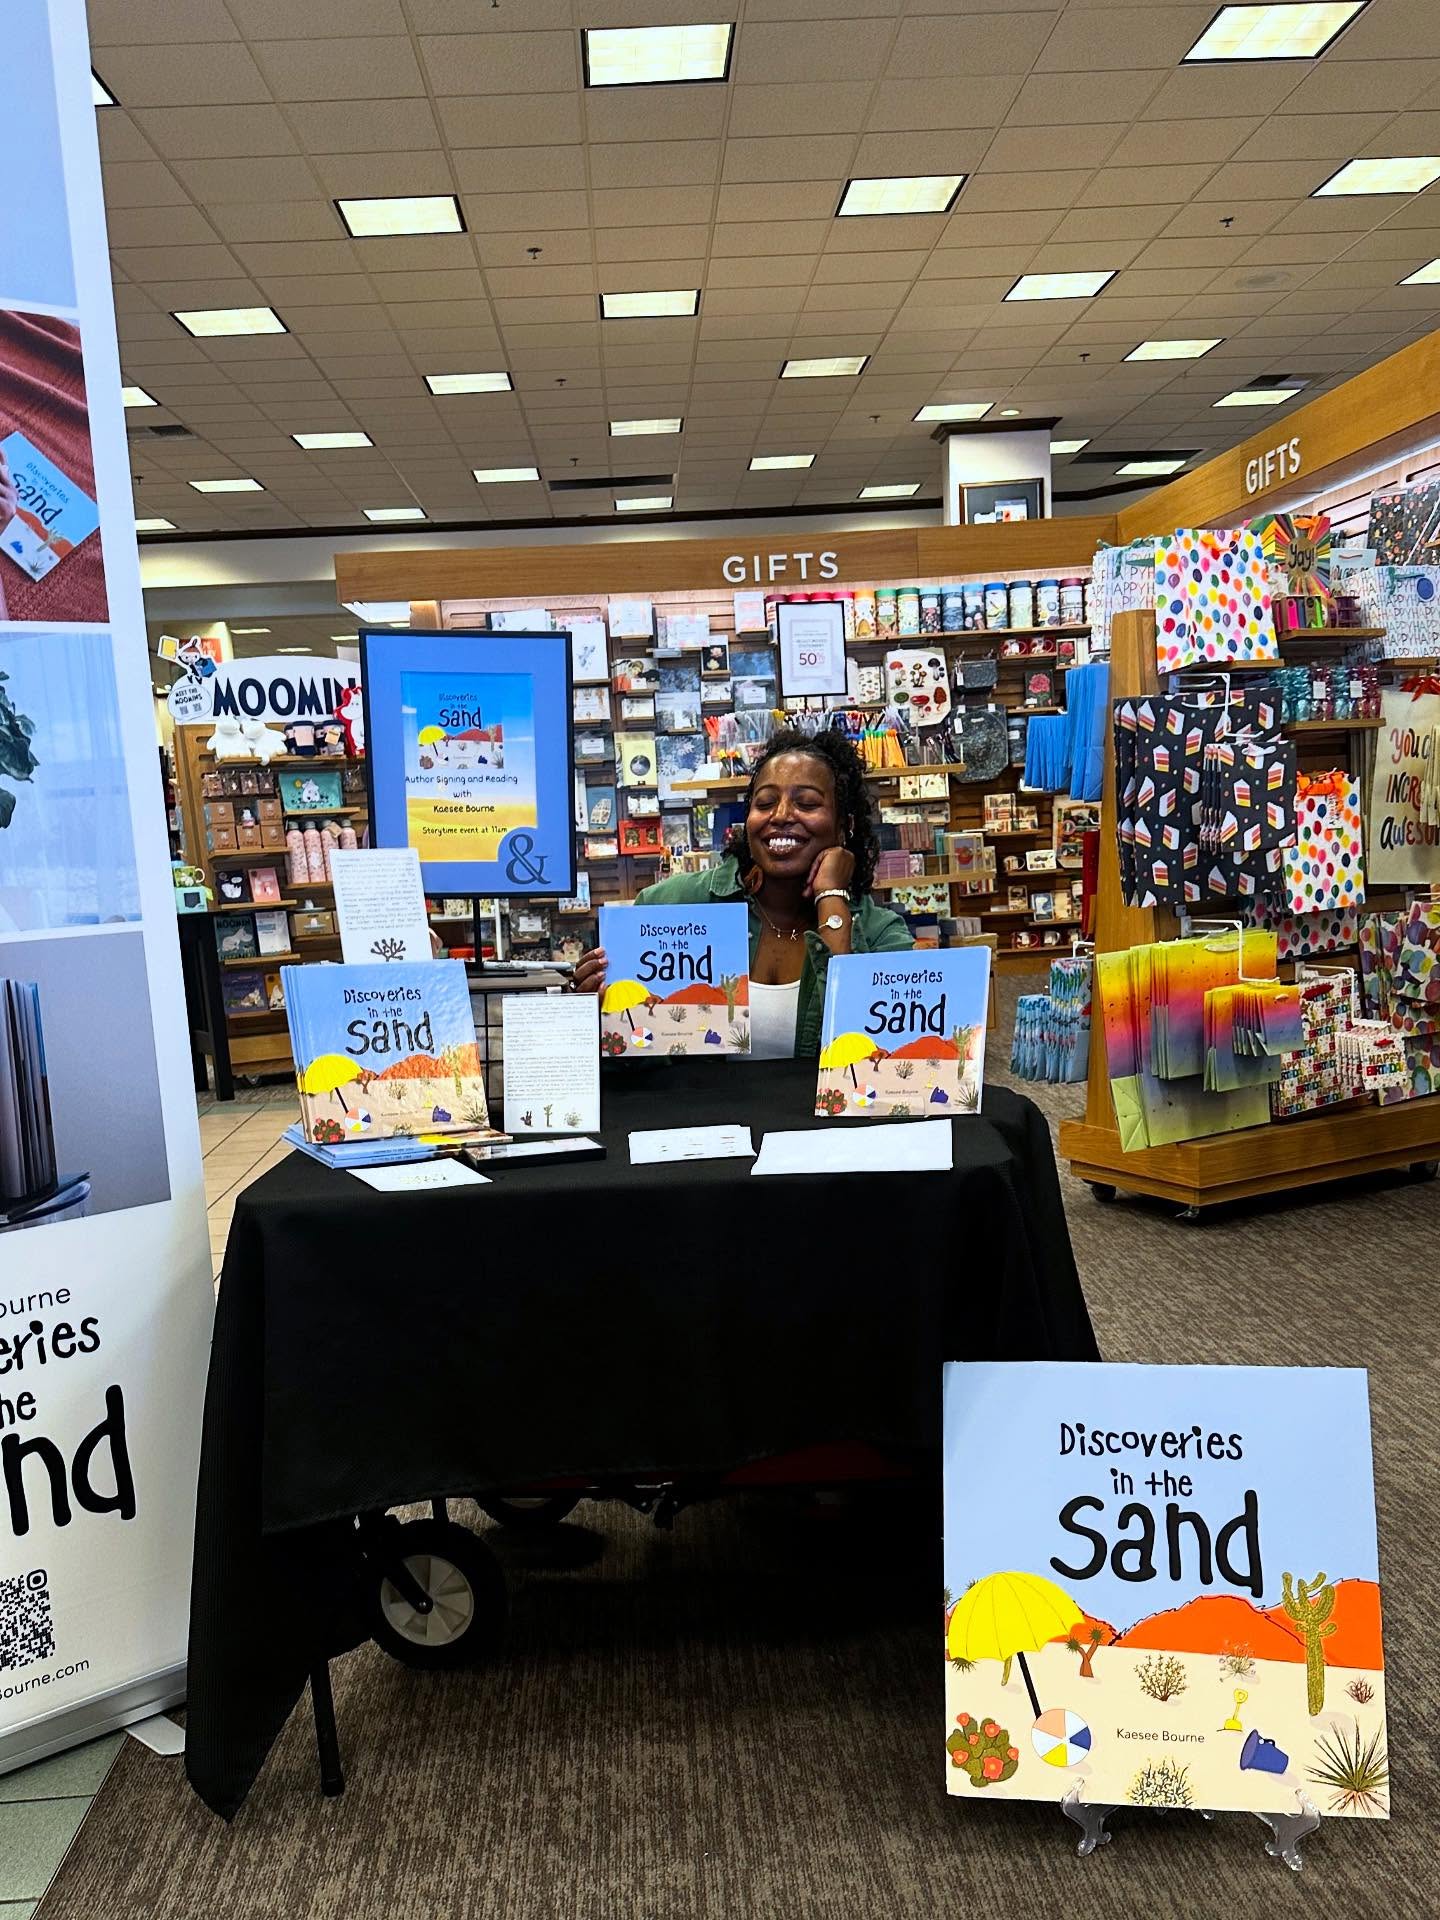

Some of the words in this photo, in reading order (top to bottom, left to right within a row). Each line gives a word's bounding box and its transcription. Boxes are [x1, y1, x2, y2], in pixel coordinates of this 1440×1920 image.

[1246, 437, 1301, 495] GIFTS
[13, 473, 63, 525] Sand
[722, 551, 839, 583] GIFTS
[1288, 543, 1315, 572] Yay!
[212, 676, 356, 717] MOOMIN
[439, 692, 478, 702] Discoveries
[438, 706, 482, 730] Sand
[405, 775, 435, 784] Author
[436, 775, 466, 786] Signing
[467, 775, 484, 783] and
[485, 775, 518, 785] Reading
[453, 789, 472, 798] with
[433, 804, 464, 813] Kaesee
[465, 804, 495, 813] Bourne
[422, 826, 458, 837] Storytime
[491, 825, 508, 833] 11am
[640, 922, 707, 937] Discoveries
[659, 940, 668, 949] in
[671, 940, 689, 950] the
[636, 945, 713, 984] Sand
[872, 970, 943, 986] Discoveries
[343, 987, 421, 1004] Discoveries
[891, 989, 900, 1000] in
[904, 988, 922, 999] the
[367, 1007, 378, 1018] in
[382, 1006, 402, 1017] the
[864, 993, 946, 1036] Sand
[345, 1010, 435, 1055] Sand
[0, 1287, 71, 1319] ourne
[0, 1316, 101, 1376] eries
[0, 1391, 36, 1429] he
[1060, 1422, 1244, 1461] Discoveries
[1, 1384, 137, 1537] nd
[1110, 1467, 1134, 1496] in
[1145, 1469, 1193, 1497] the
[1049, 1489, 1263, 1598] Sand
[0, 1659, 90, 1701] ourne.com
[1116, 1728, 1159, 1741] Kaesee
[1162, 1730, 1205, 1743] Bourne
